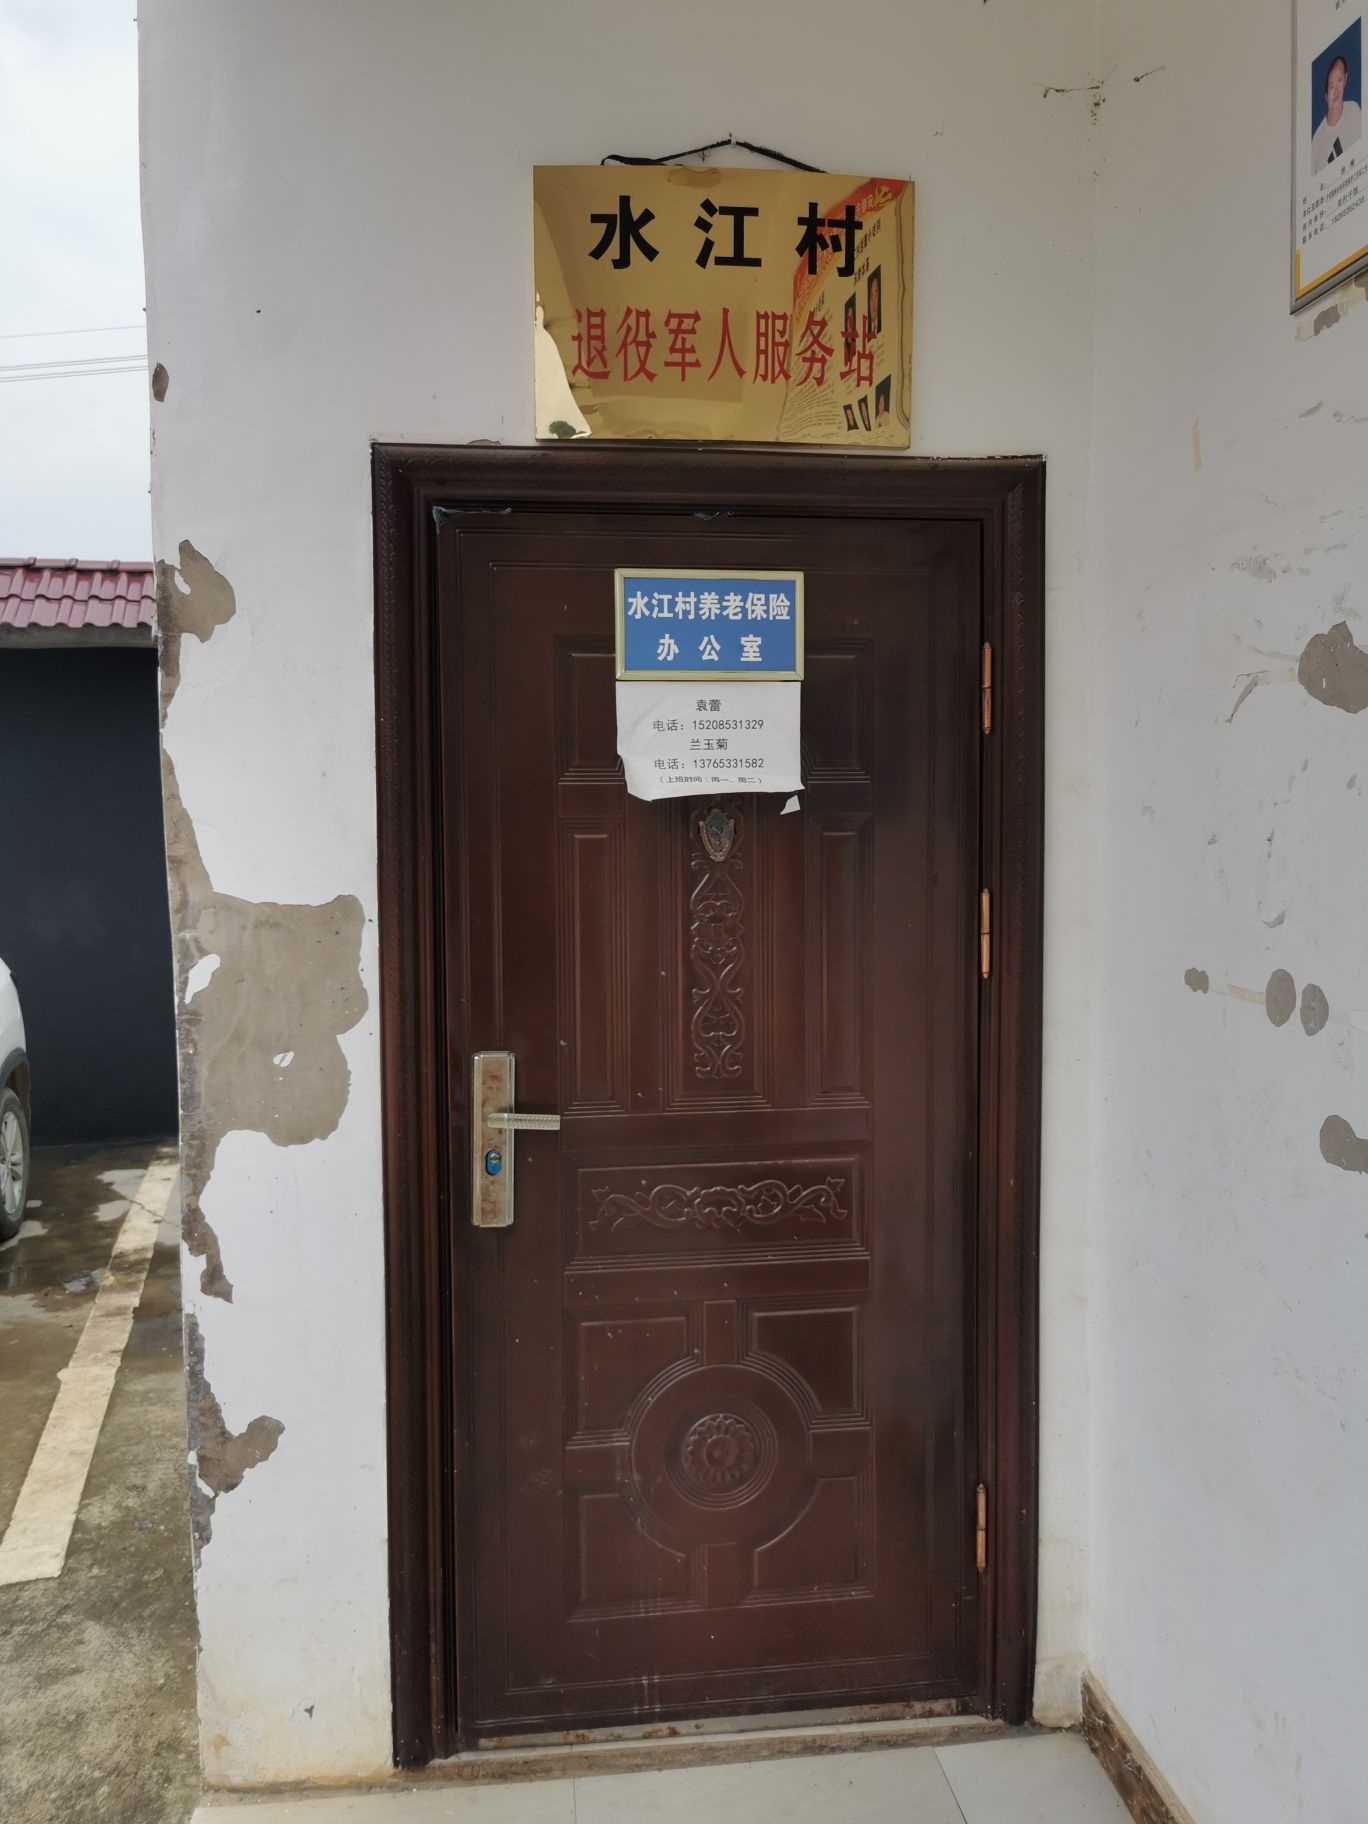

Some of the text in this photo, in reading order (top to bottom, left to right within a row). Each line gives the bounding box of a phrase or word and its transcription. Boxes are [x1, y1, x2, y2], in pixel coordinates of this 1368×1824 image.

[588, 195, 863, 277] 水江村
[571, 306, 878, 387] 退役军人服务站
[627, 591, 791, 621] 水江村养老保险
[657, 634, 763, 662] 办公室
[696, 699, 722, 712] 袁蕾
[689, 738, 728, 751] 兰玉菊
